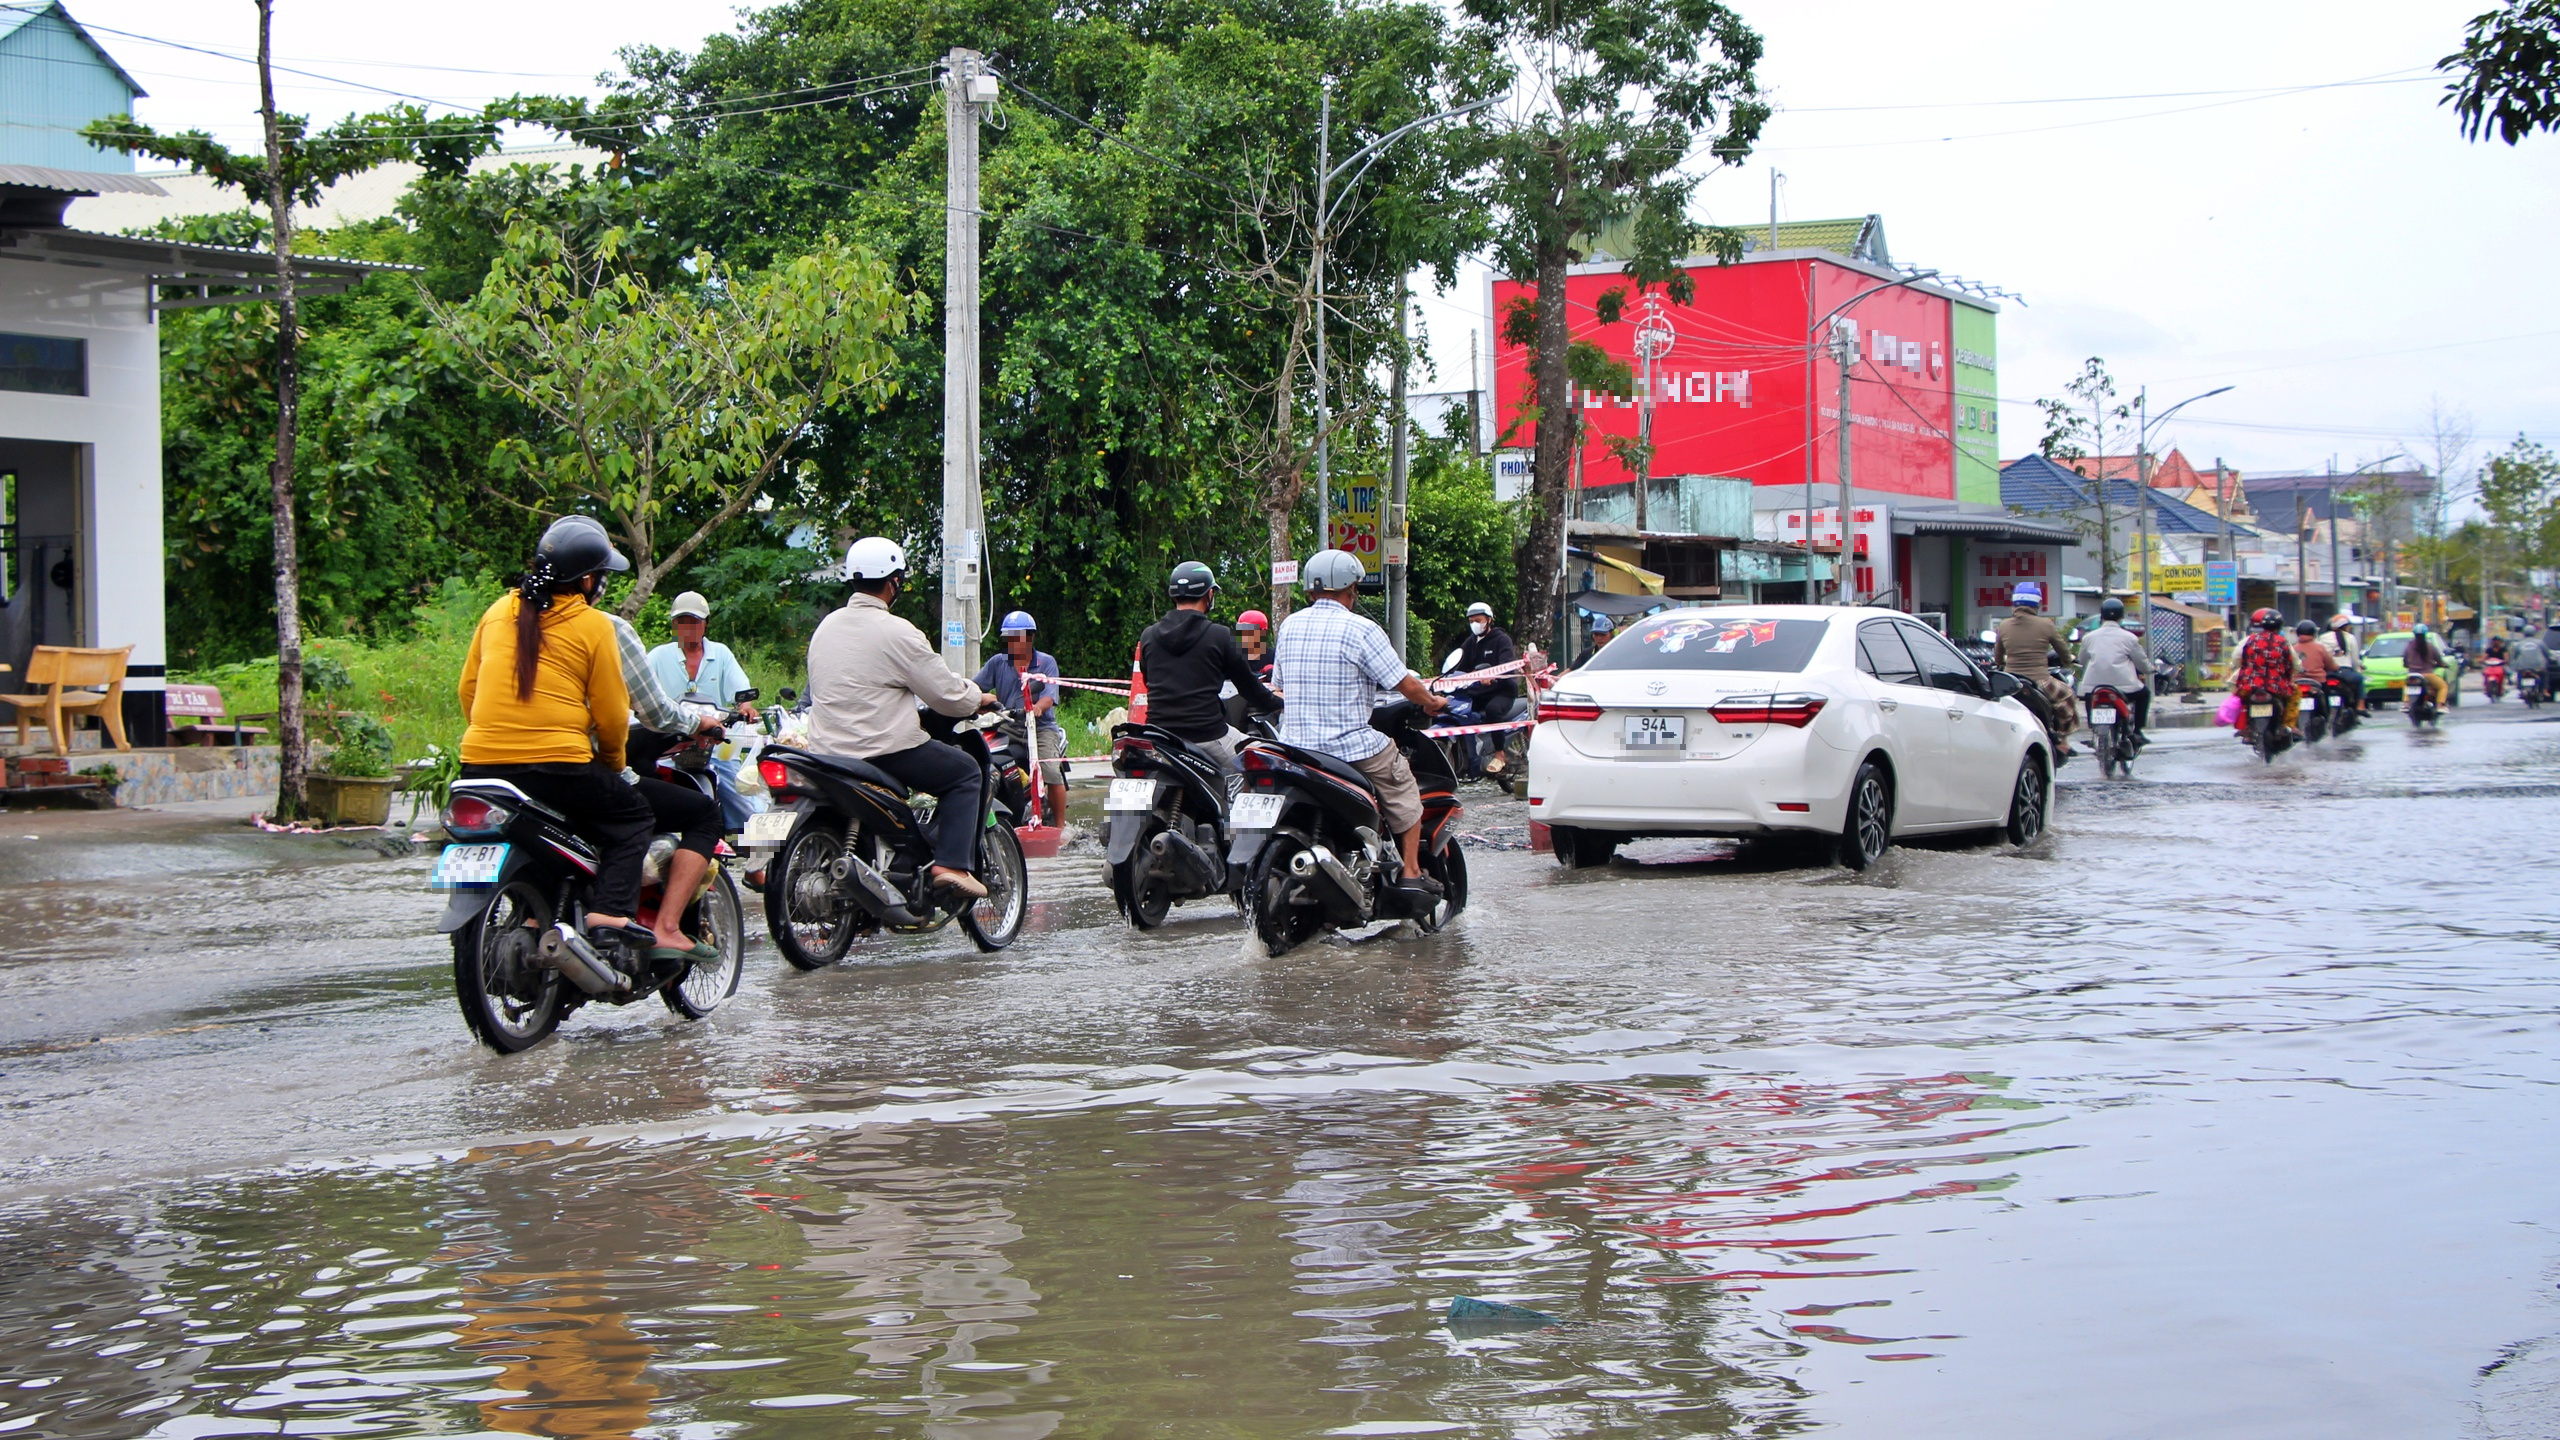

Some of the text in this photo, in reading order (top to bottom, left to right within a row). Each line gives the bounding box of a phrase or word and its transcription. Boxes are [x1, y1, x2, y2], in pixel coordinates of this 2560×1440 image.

[1352, 486, 1377, 519] TRỌ
[1340, 522, 1377, 554] 26
[1275, 562, 1296, 574] BÁN ĐẤT
[2164, 567, 2180, 578] CƠM
[2181, 567, 2202, 578] NGON
[184, 692, 208, 706] TÂM
[1641, 718, 1667, 731] 94A
[1118, 781, 1148, 793] 94-D1
[1240, 796, 1276, 810] 94-R1
[756, 815, 788, 828] 94-B1
[454, 846, 497, 863] 94-B1
